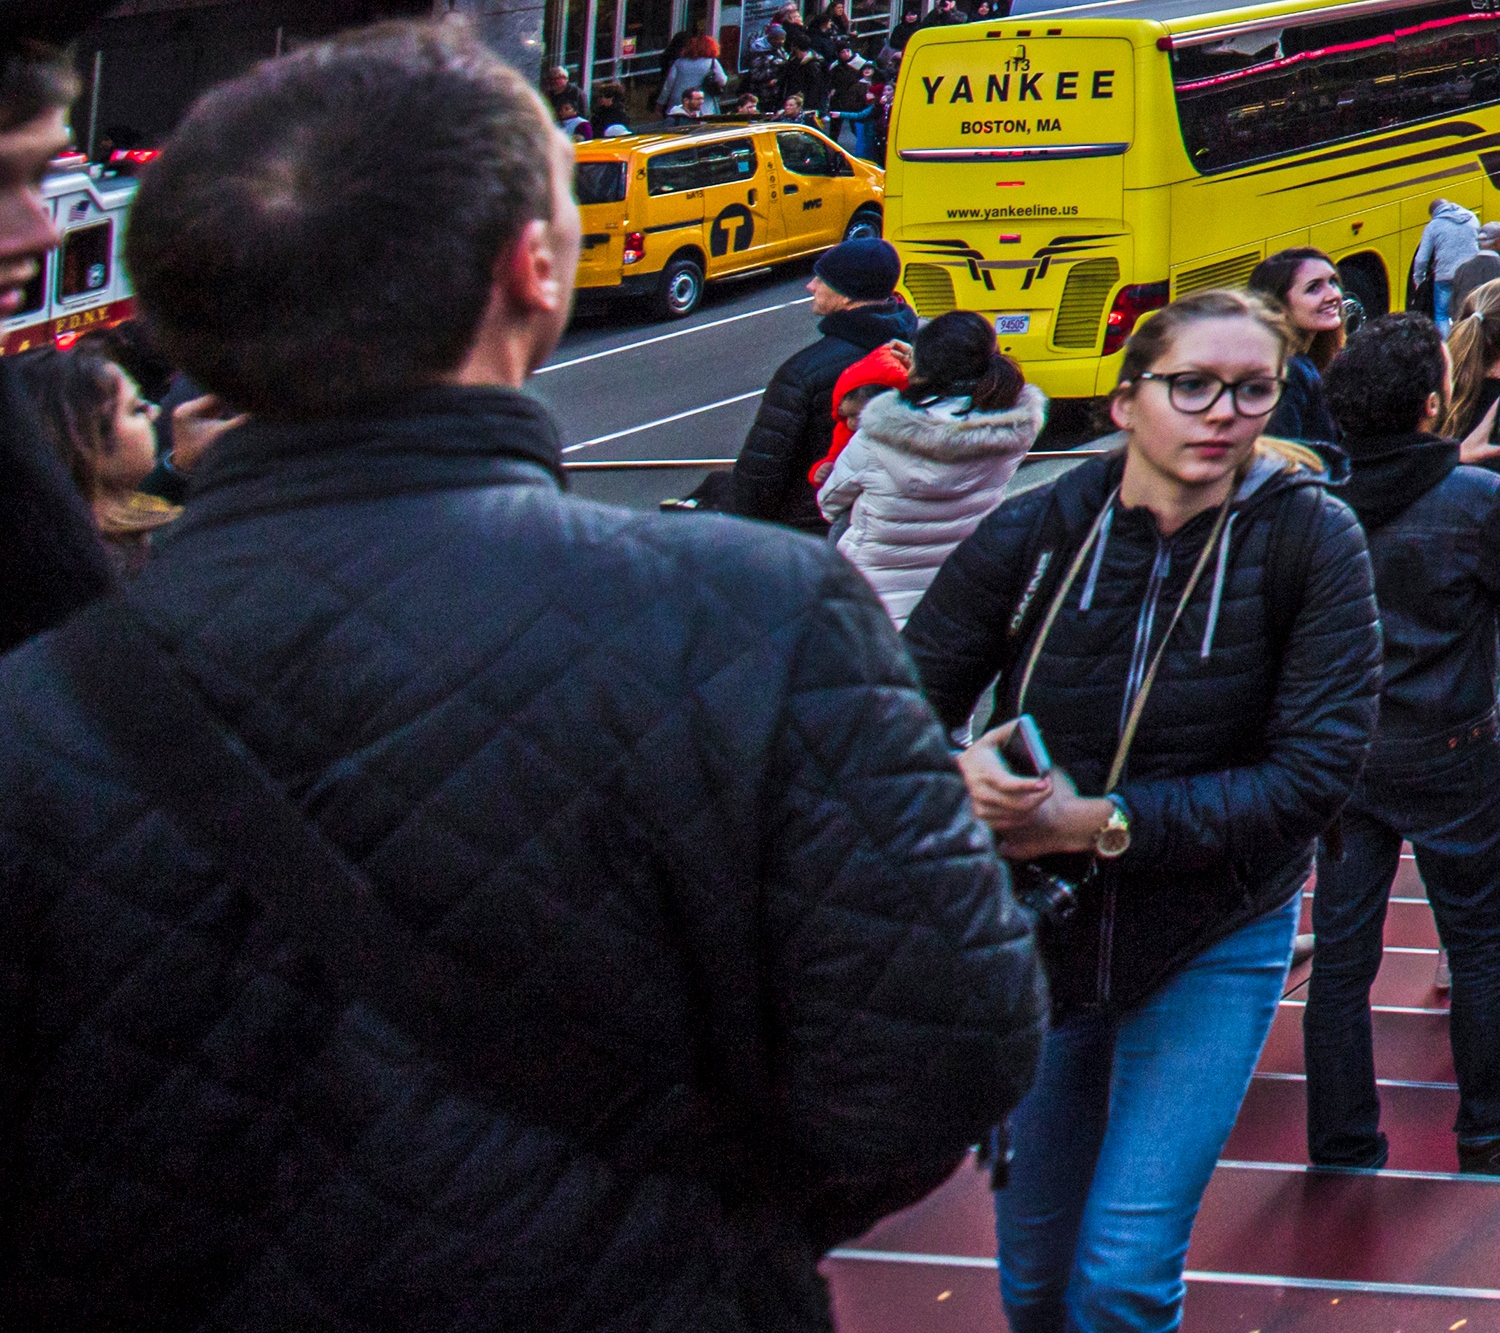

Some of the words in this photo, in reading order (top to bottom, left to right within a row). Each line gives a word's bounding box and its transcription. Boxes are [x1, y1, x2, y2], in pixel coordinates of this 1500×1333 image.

[922, 70, 1115, 104] YANKEE
[961, 120, 1031, 135] BOSTON,
[1037, 118, 1062, 132] MA
[947, 204, 1079, 219] www.yankeeline.us
